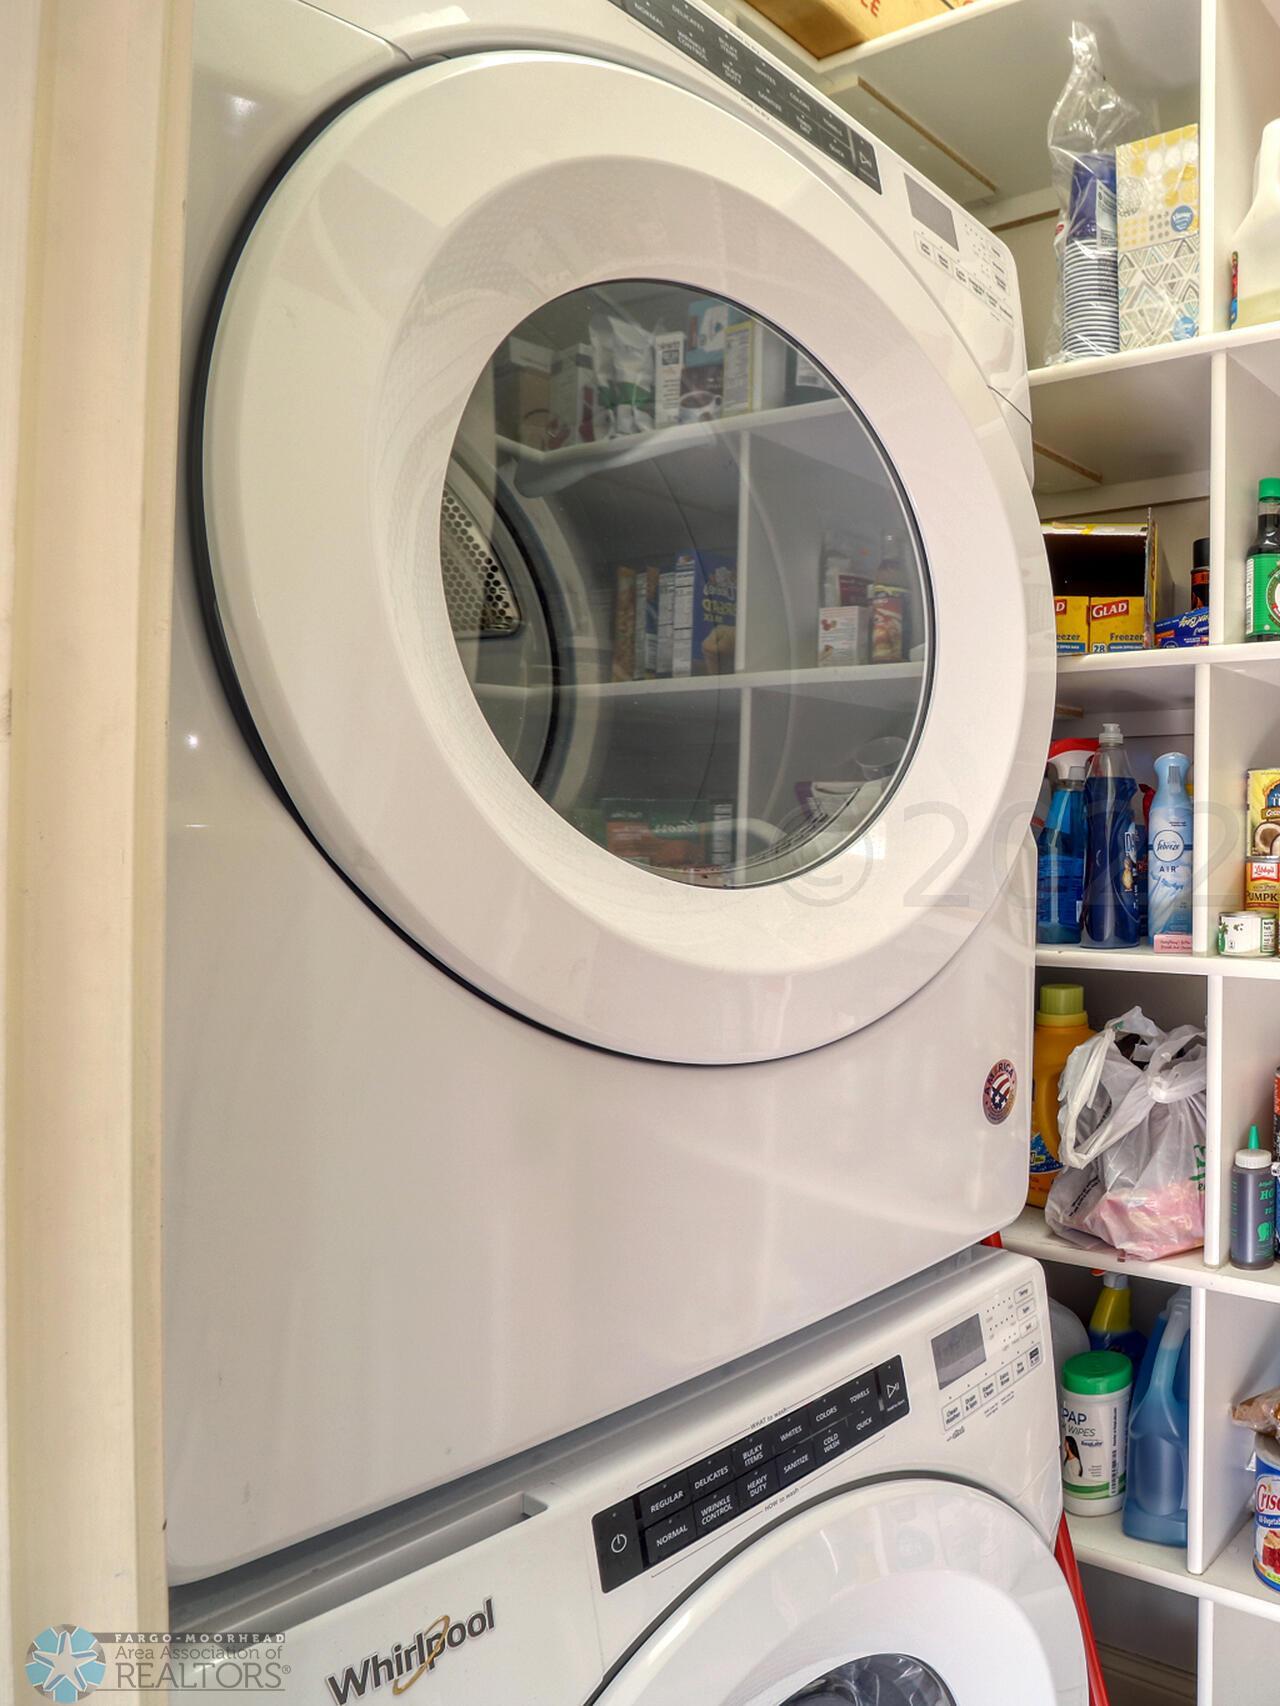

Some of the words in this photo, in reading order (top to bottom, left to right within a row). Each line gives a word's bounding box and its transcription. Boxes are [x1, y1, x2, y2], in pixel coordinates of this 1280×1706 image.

[634, 2, 664, 28] NORMAL
[1092, 602, 1128, 619] GLAD
[1093, 644, 1105, 652] 28
[1160, 865, 1176, 873] AIR
[849, 1387, 871, 1404] TOWELS
[750, 1417, 767, 1430] WHAT
[773, 1407, 788, 1418] wash
[815, 1405, 838, 1422] COLORS
[855, 1416, 873, 1431] QUICK
[1068, 1426, 1096, 1437] WIPES
[779, 1425, 802, 1442] WHITES
[823, 1433, 839, 1447] COLD
[742, 1443, 763, 1461] BULKY
[823, 1439, 841, 1453] WASH
[744, 1452, 764, 1467] ITEMS
[783, 1454, 809, 1474] SANITIZE
[694, 1466, 729, 1490] DELICATES
[747, 1474, 769, 1491] HEAVY
[749, 1483, 768, 1498] DUTY
[650, 1490, 684, 1513] REGULAR
[700, 1495, 731, 1518] WRINKLE
[764, 1501, 779, 1513] HOW
[784, 1488, 800, 1501] wash
[701, 1503, 733, 1526] CONTROL
[656, 1523, 688, 1547] NORMAL
[328, 1597, 495, 1706] Whirlpool
